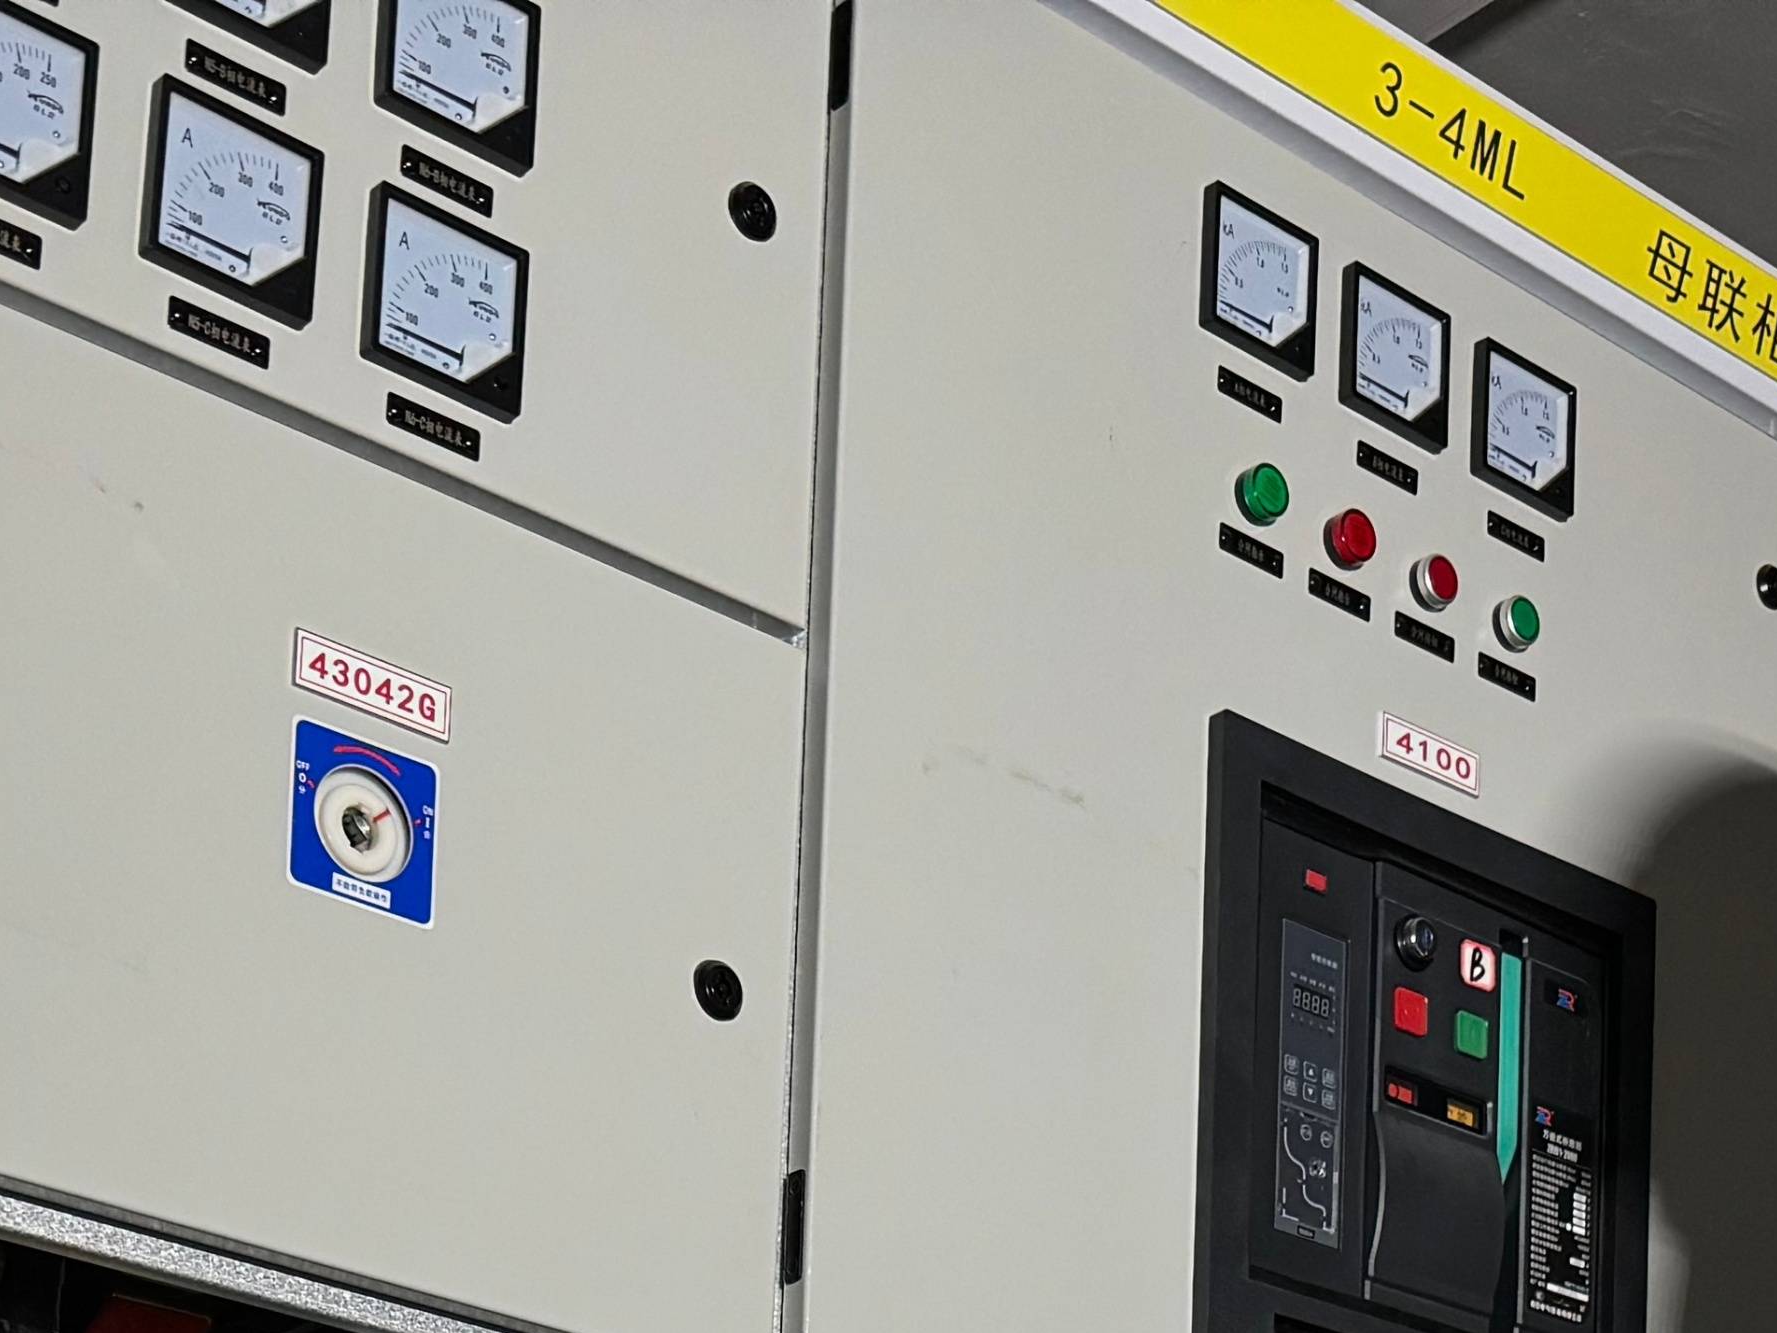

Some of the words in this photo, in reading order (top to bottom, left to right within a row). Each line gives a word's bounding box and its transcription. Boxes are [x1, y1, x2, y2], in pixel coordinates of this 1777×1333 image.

[13, 63, 30, 80] 200
[40, 72, 57, 88] 250
[181, 128, 194, 148] A
[1373, 61, 1525, 201] 3-4ML
[238, 172, 253, 188] 300
[208, 181, 225, 198] 200
[268, 181, 284, 197] 400
[188, 210, 203, 226] 100
[398, 231, 410, 250] A
[450, 272, 465, 288] 300
[479, 280, 494, 295] 400
[424, 283, 439, 299] 200
[405, 311, 419, 326] 100
[309, 652, 436, 722] 43042G
[1396, 732, 1471, 780] 4100
